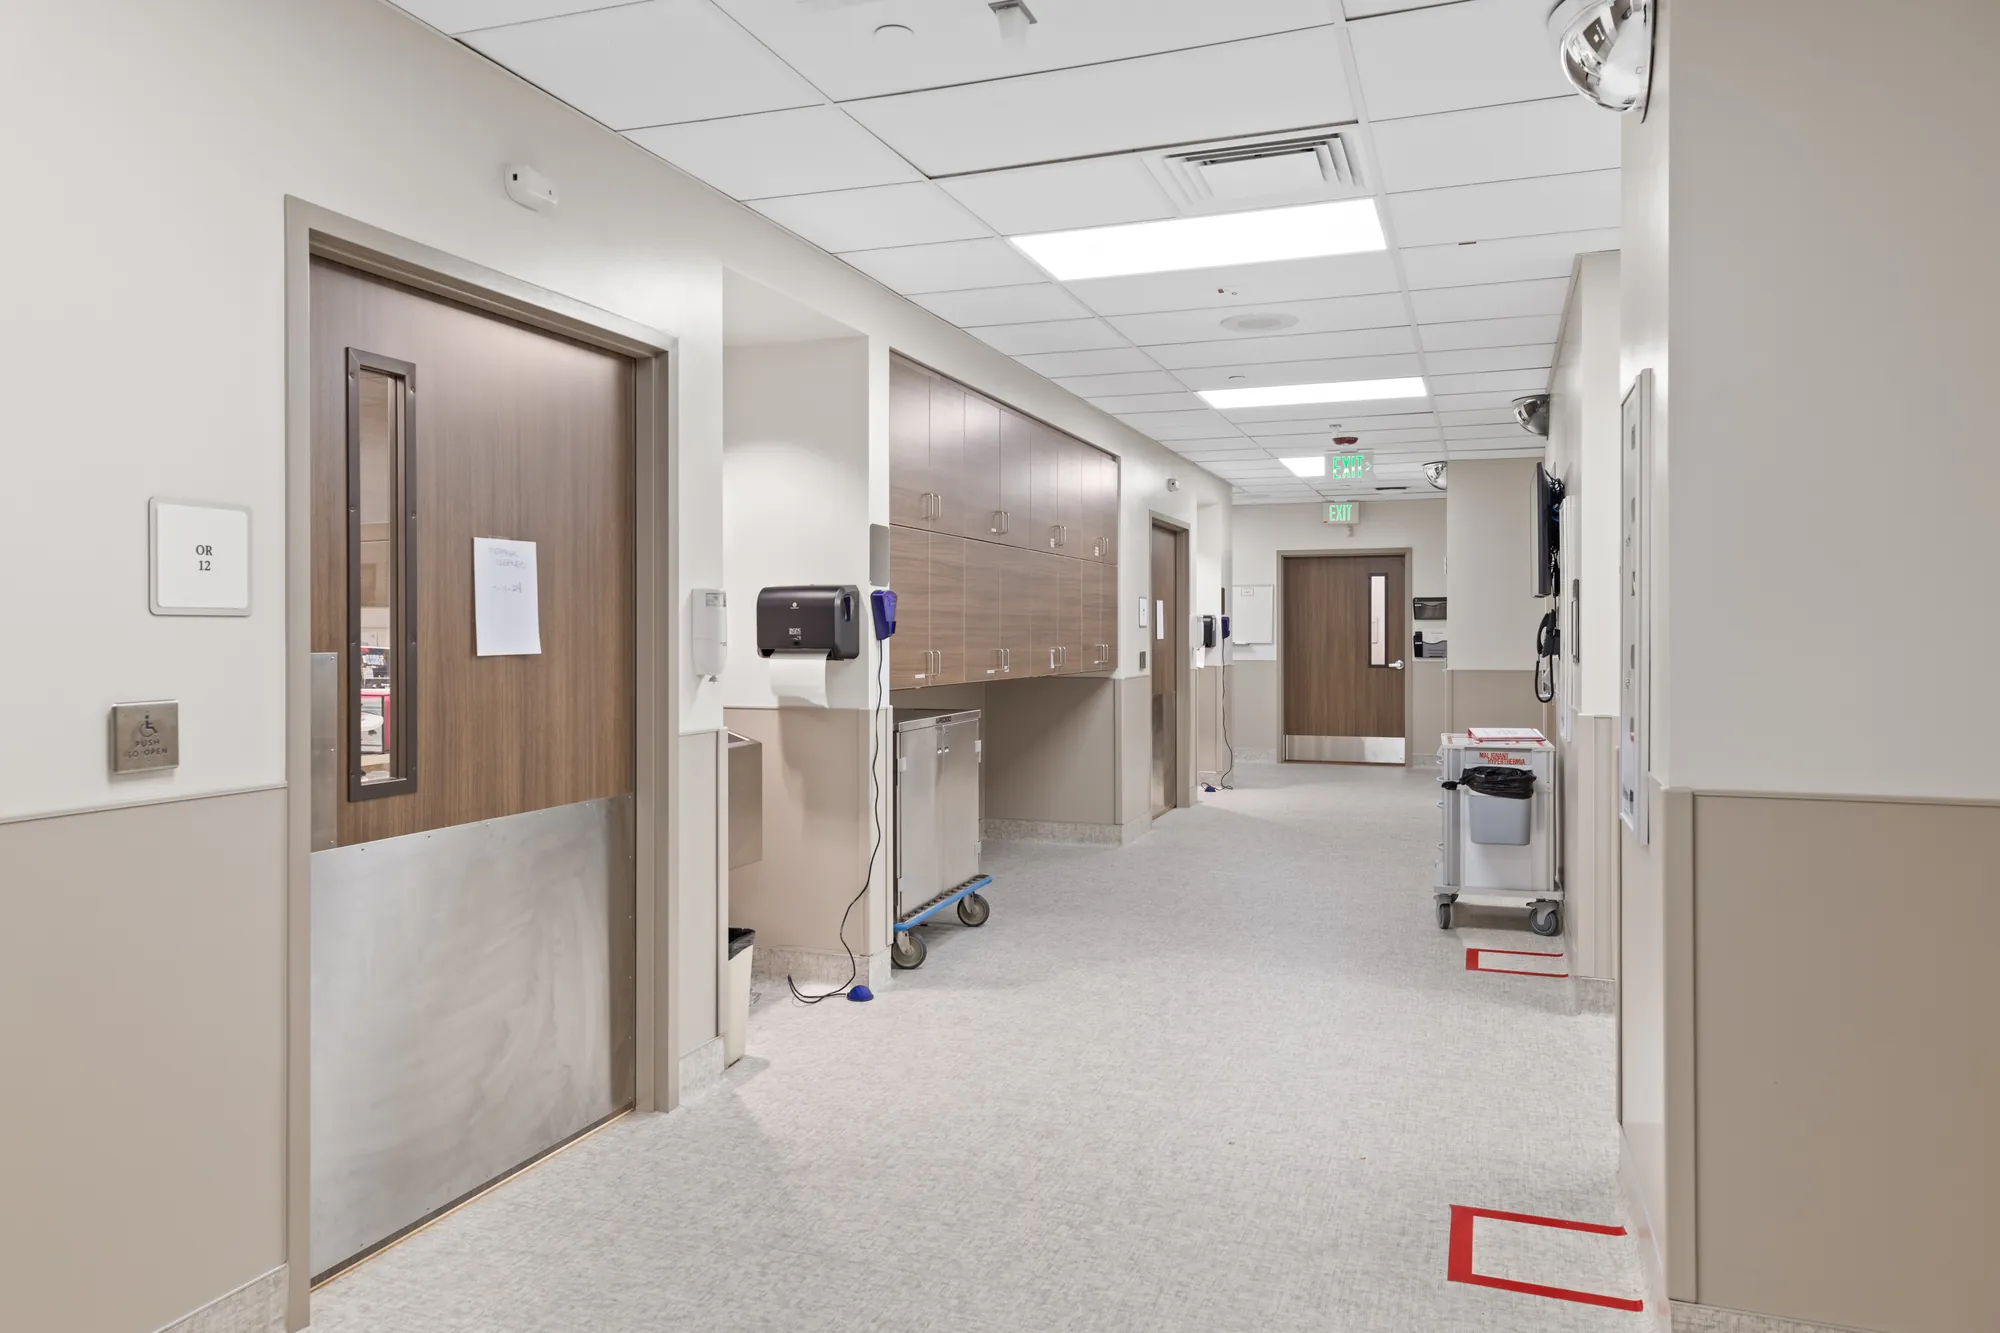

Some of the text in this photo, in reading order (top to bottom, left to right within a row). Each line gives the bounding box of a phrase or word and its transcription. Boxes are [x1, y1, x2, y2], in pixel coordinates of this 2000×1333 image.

[1333, 455, 1364, 479] EXIT
[1329, 504, 1352, 521] EXIT
[195, 544, 213, 556] OR
[198, 560, 211, 571] 12
[135, 739, 160, 748] PUSH
[128, 748, 168, 758] TO OPEN
